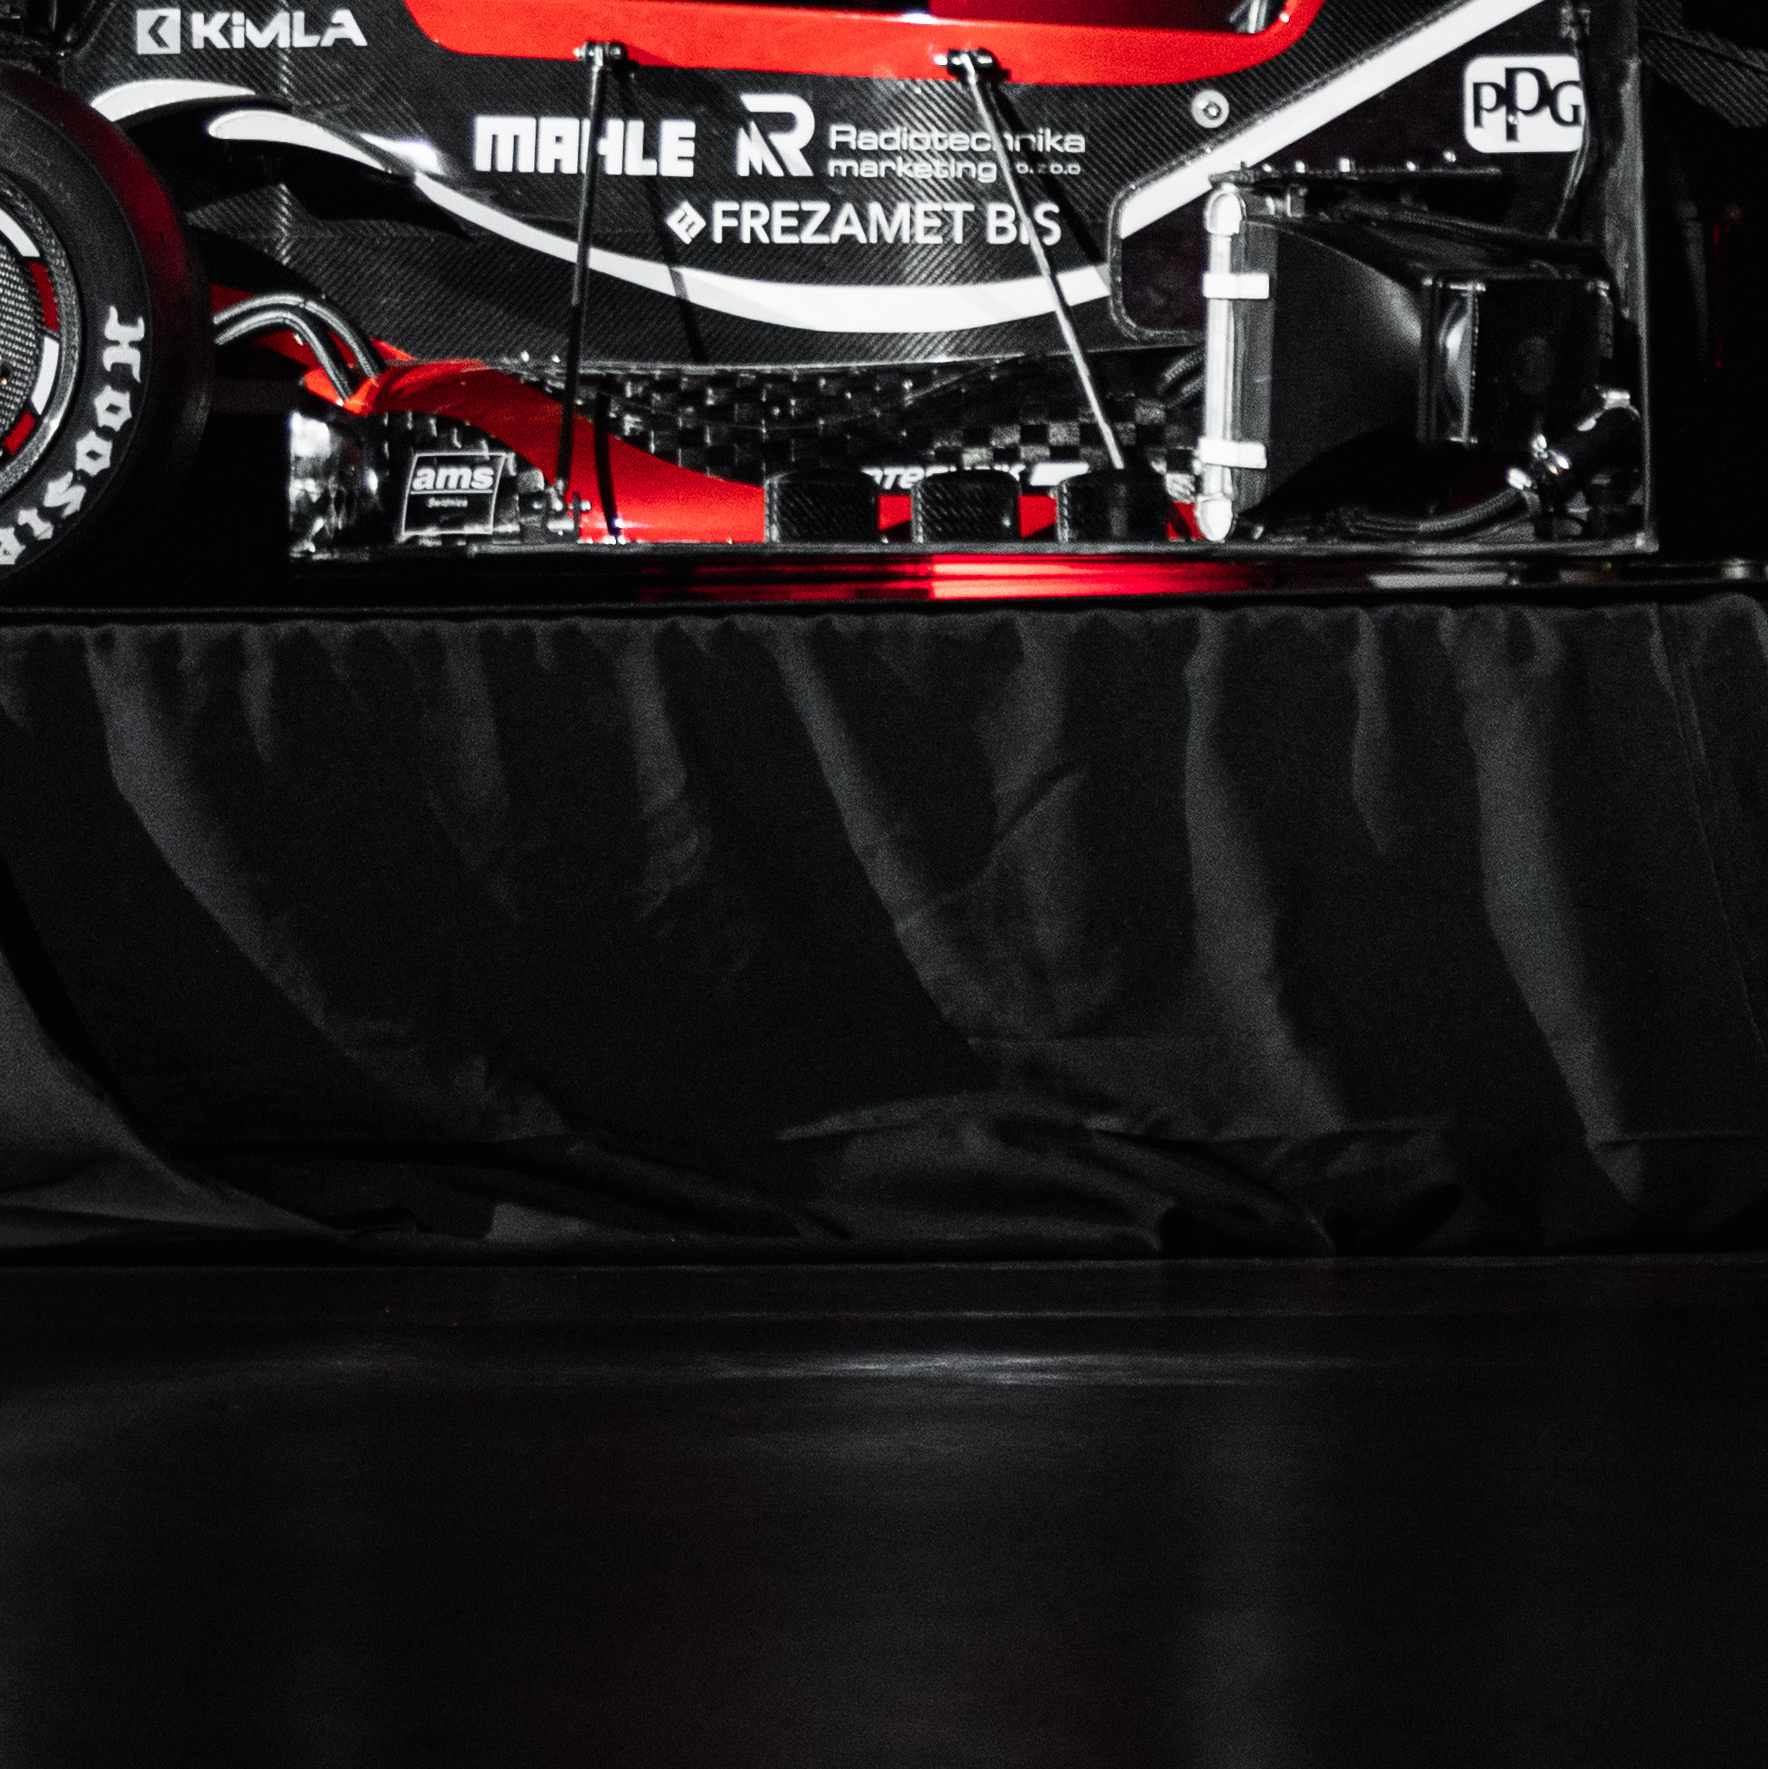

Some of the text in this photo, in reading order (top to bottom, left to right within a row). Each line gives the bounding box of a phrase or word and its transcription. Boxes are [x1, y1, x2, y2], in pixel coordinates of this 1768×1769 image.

[1471, 66, 1584, 143] PPG
[473, 115, 697, 178] MAHLE
[827, 156, 998, 184] marketing
[711, 201, 975, 245] FREZAMET
[411, 465, 495, 491] ams
